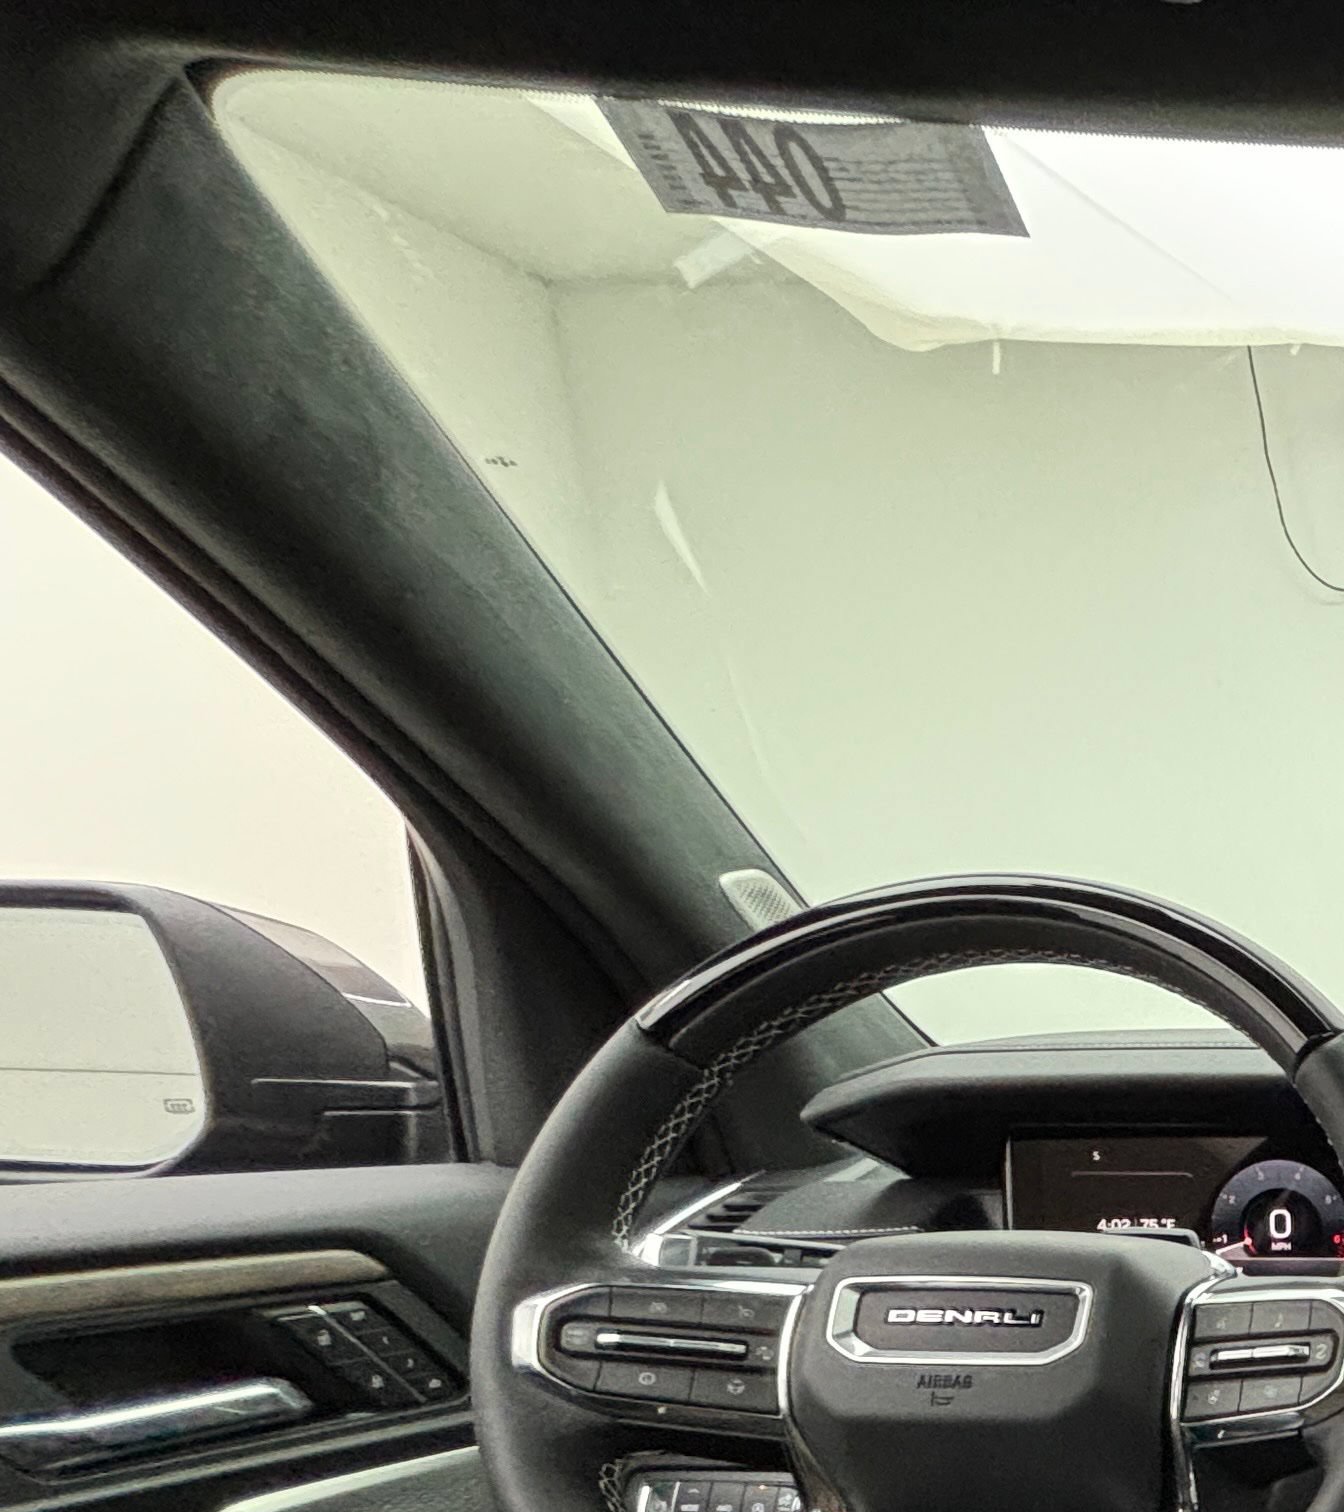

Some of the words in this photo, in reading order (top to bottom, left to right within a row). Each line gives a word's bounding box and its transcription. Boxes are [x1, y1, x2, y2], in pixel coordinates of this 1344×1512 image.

[1228, 1195, 1236, 1205] 2
[1096, 1218, 1132, 1231] 4:02
[1268, 1208, 1292, 1239] 0
[1270, 1241, 1292, 1251] MPH
[886, 1308, 1044, 1327] DENALI
[916, 1375, 973, 1389] AIRBAG
